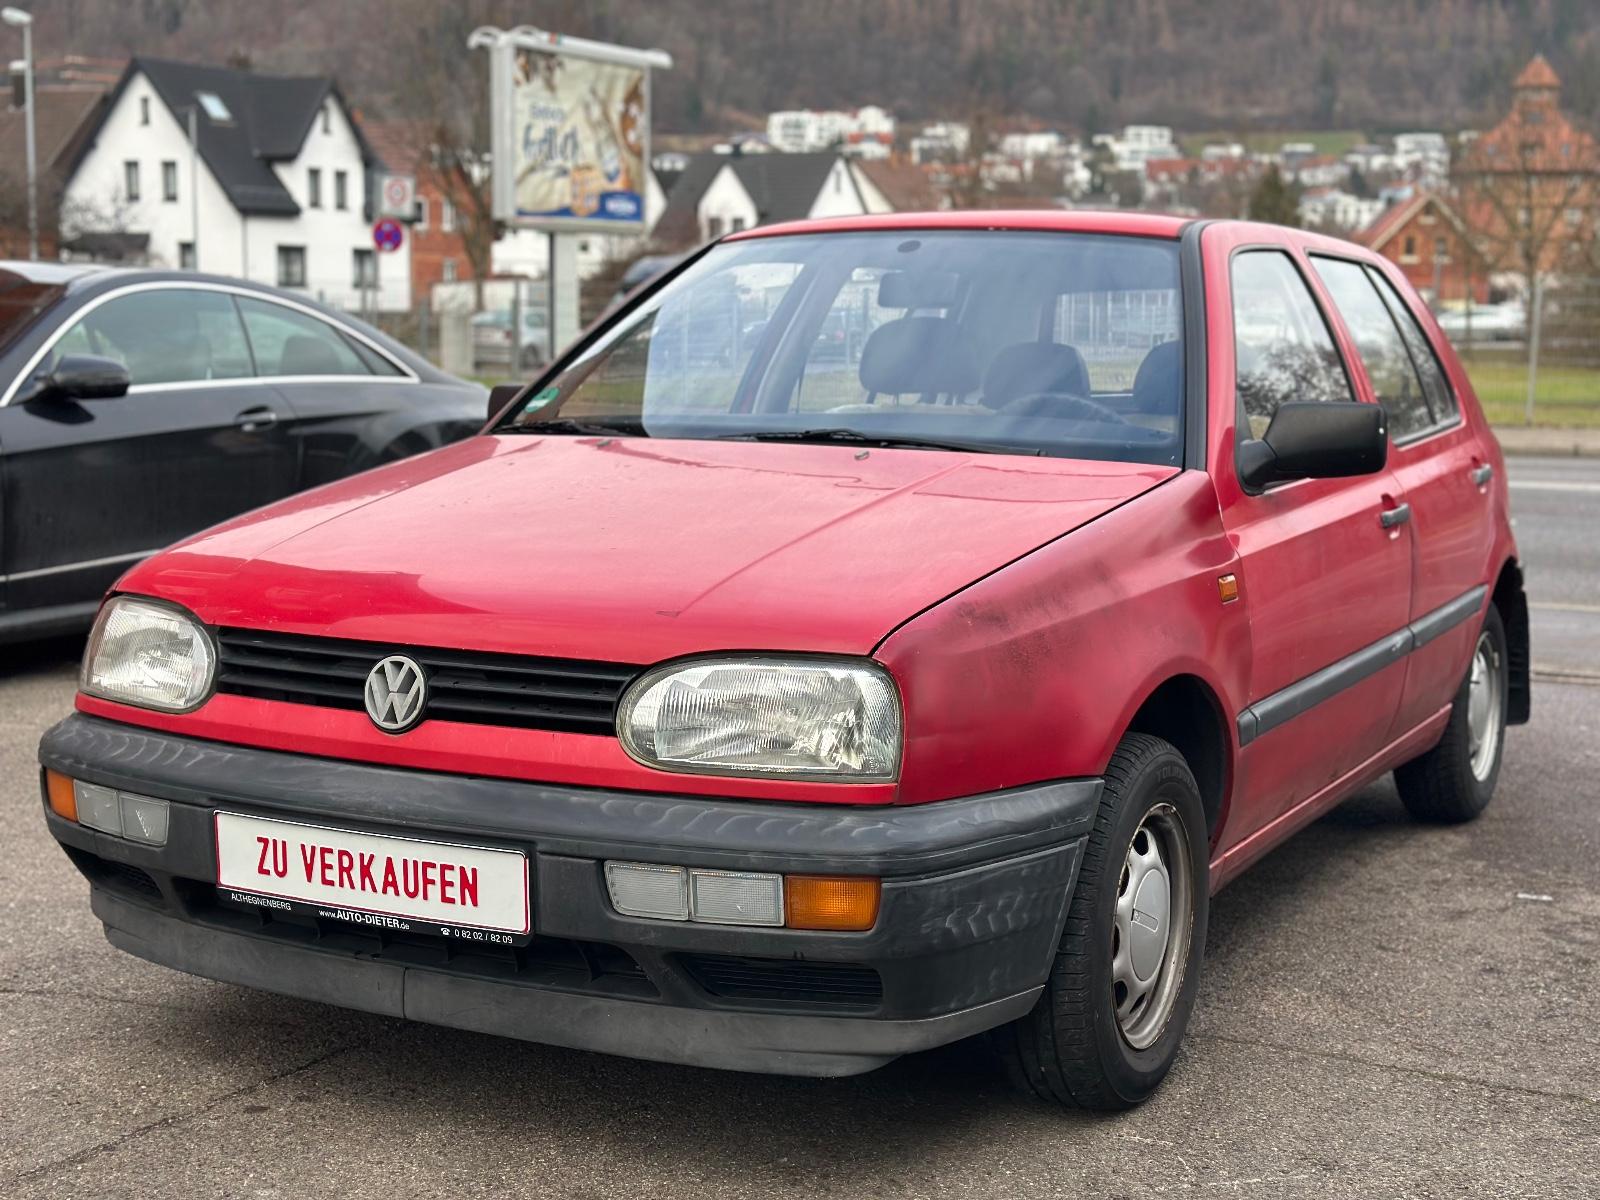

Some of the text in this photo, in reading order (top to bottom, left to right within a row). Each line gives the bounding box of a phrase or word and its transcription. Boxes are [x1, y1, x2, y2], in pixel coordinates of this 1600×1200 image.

[256, 836, 478, 907] ZU VERKAUFEN
[231, 892, 292, 911] ALTHEGNENBERG
[319, 909, 410, 930] www.AUTO-DIETER.de
[454, 928, 460, 938] 0
[461, 929, 472, 939] 82
[473, 931, 484, 941] 02
[490, 933, 501, 943] 82
[502, 935, 513, 944] 09
